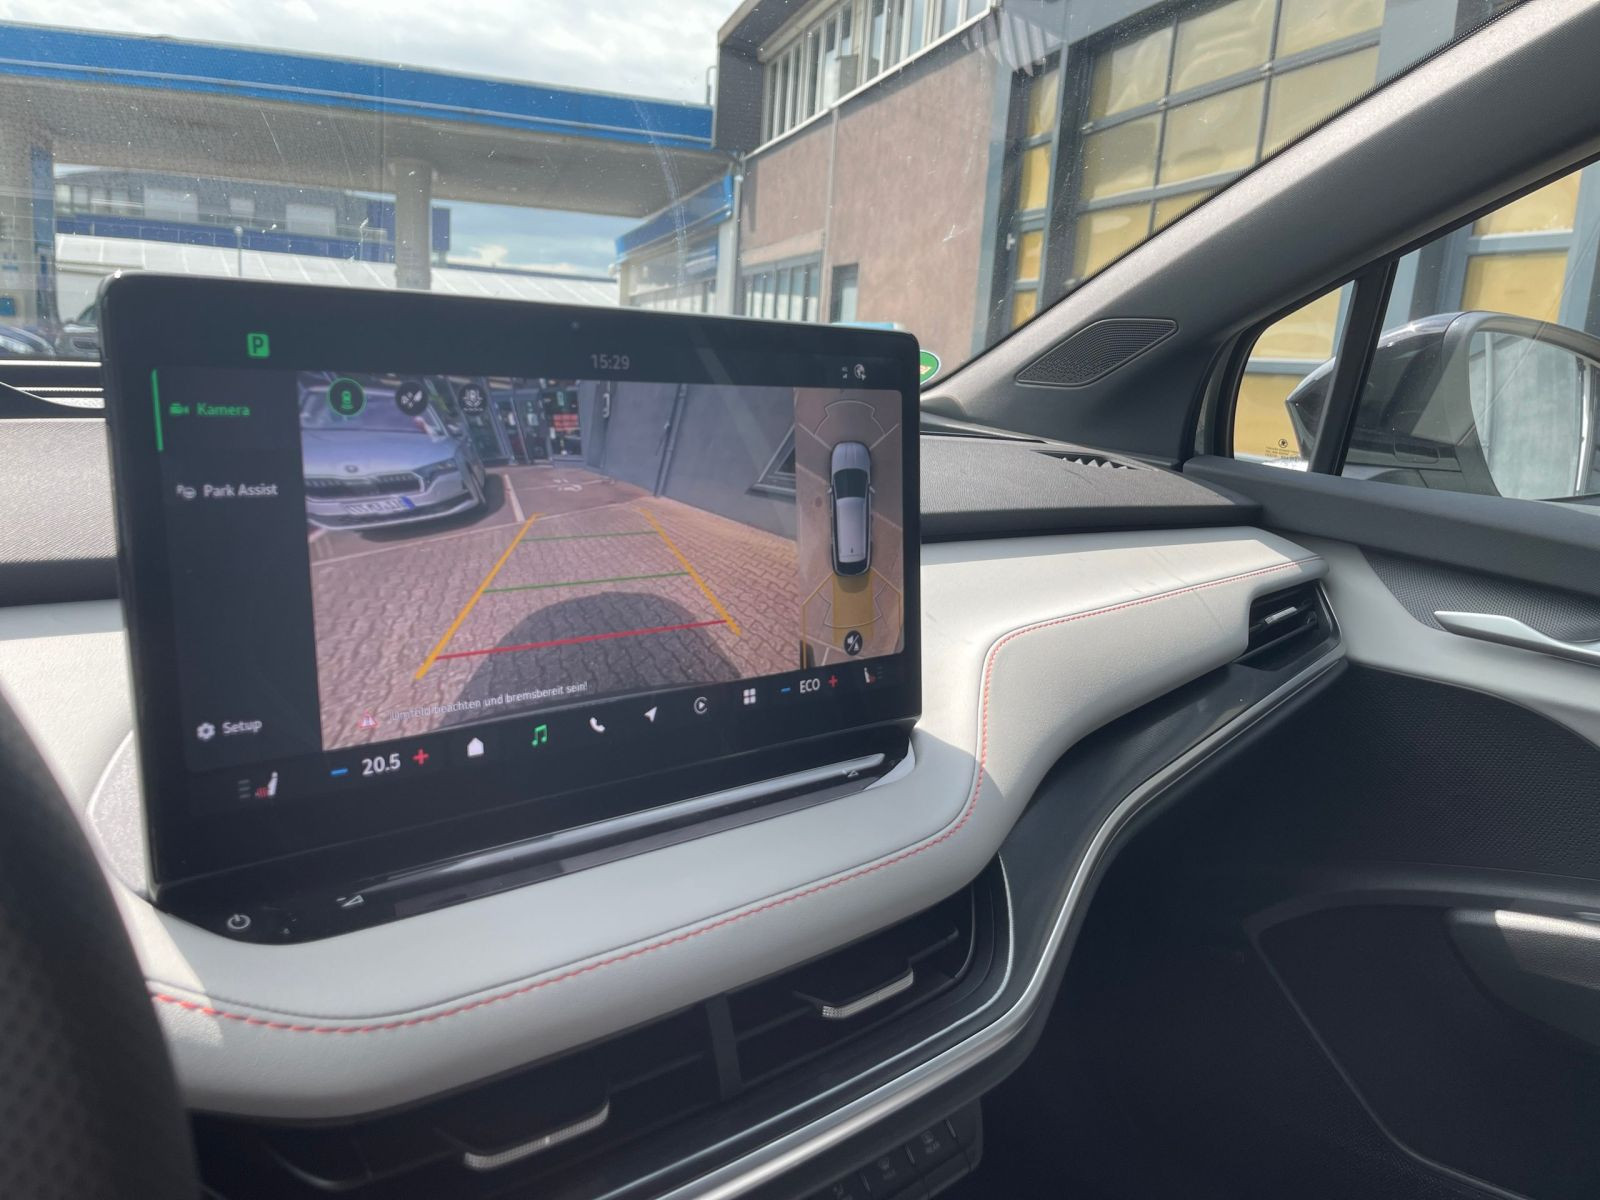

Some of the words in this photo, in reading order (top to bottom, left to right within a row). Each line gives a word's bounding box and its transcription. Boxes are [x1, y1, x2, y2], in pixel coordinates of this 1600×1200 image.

[590, 354, 630, 370] 15:29
[197, 402, 250, 416] Kamera
[203, 483, 235, 498] Park
[238, 482, 279, 497] Assist
[800, 678, 820, 693] ECO
[434, 699, 480, 715] beachten
[485, 694, 503, 707] und
[505, 686, 564, 703] bremsbereit
[566, 681, 588, 695] sein!
[222, 720, 262, 734] Setup
[362, 753, 401, 776] 20.5
